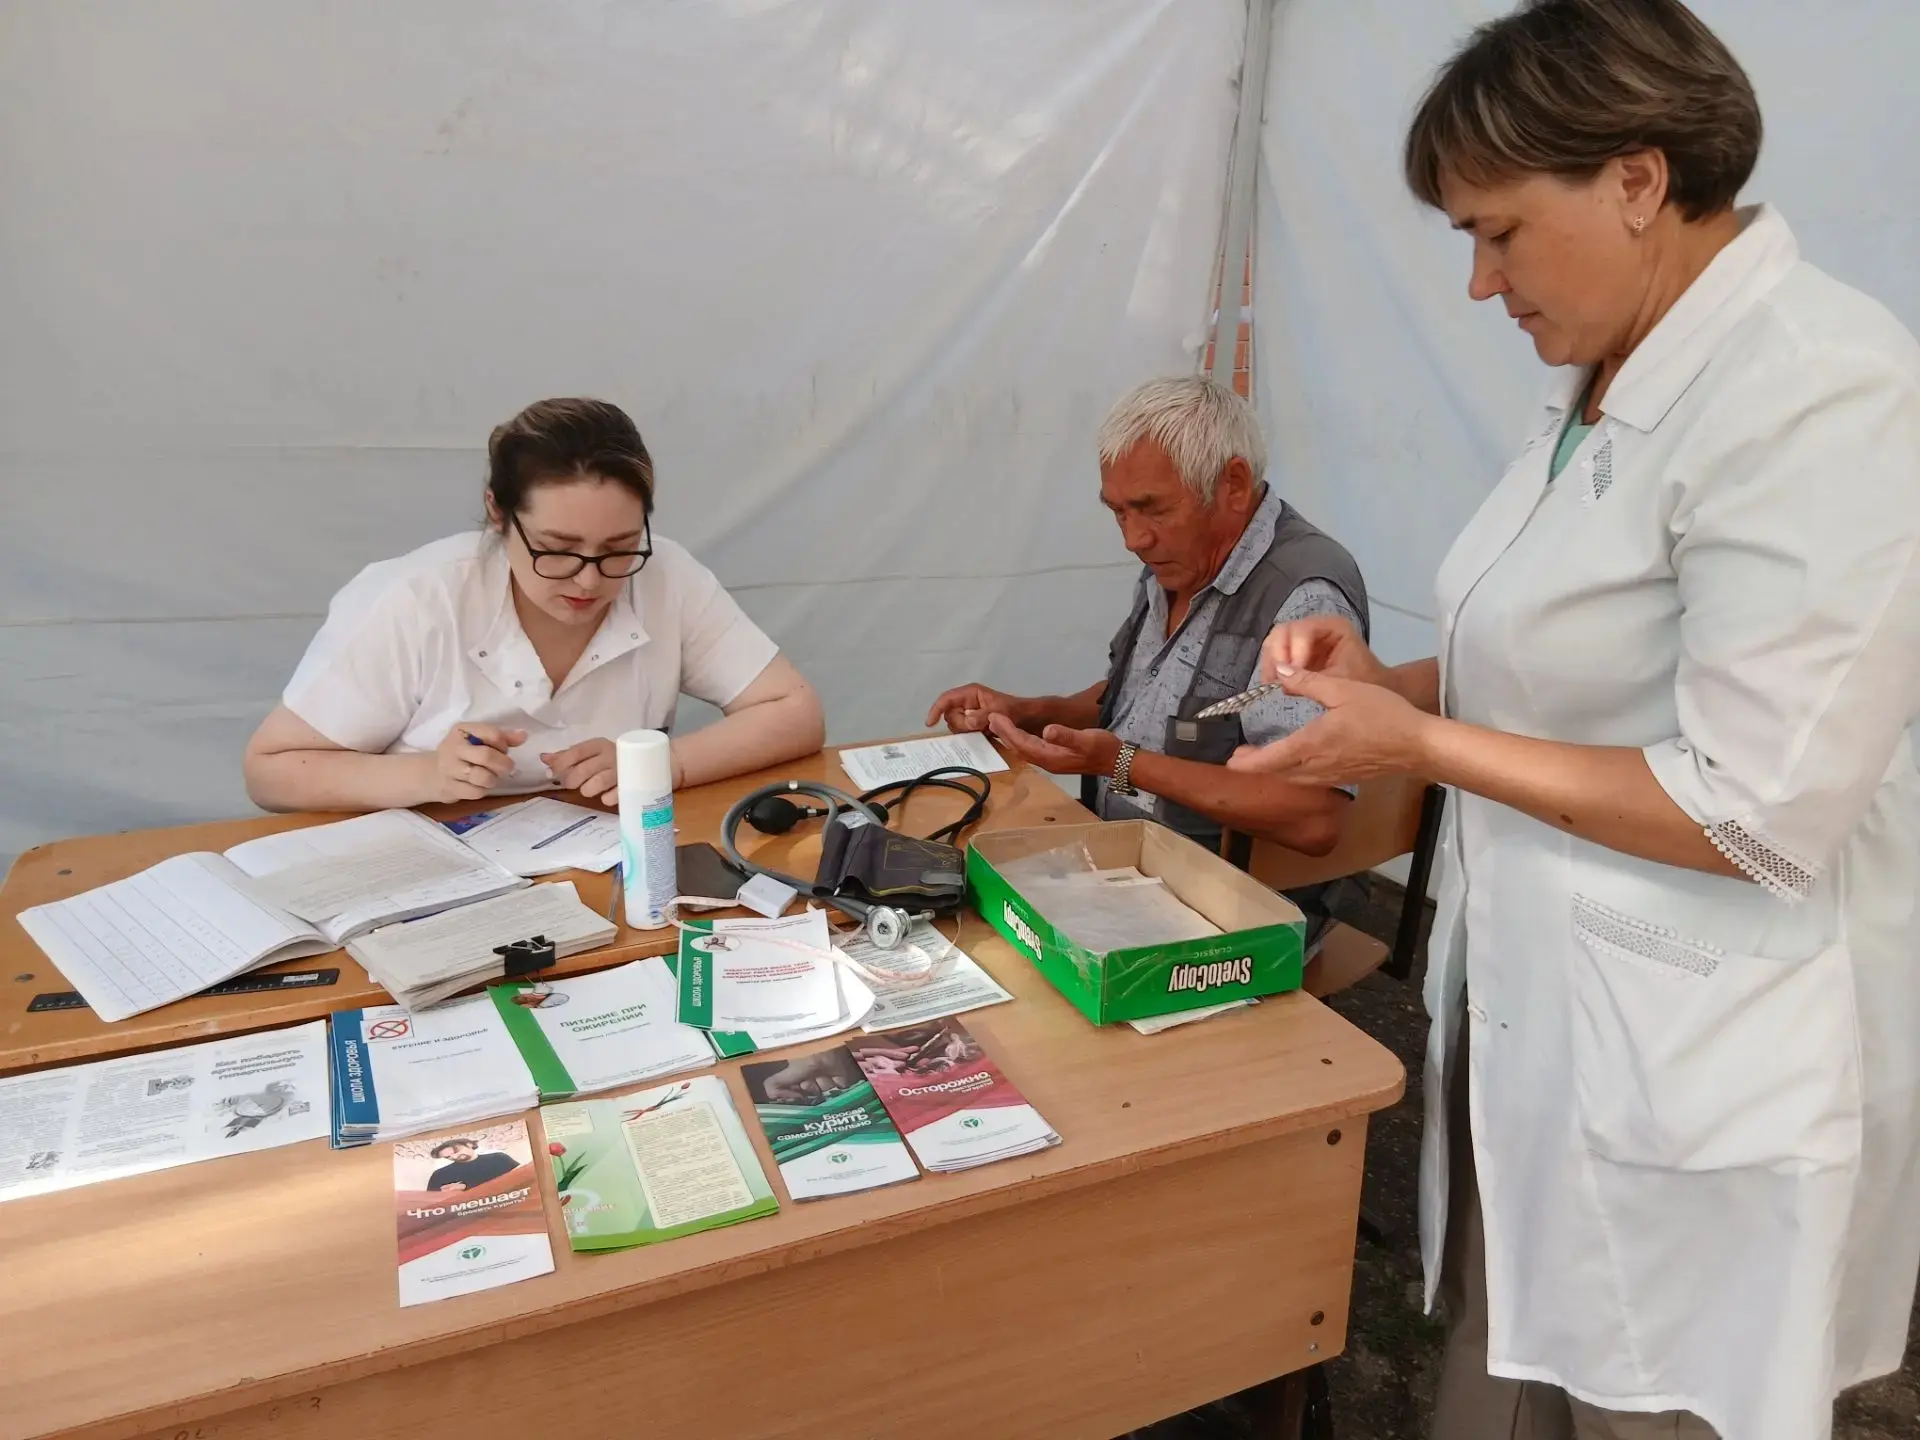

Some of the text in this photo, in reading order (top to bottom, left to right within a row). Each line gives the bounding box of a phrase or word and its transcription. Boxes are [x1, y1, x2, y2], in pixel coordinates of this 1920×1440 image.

[1194, 946, 1233, 959] CLASSIC
[1168, 957, 1252, 992] SvetoCopy
[560, 1003, 647, 1028] ПИТАНИЕ ПРИ
[572, 1011, 644, 1033] ОЖИРЕНИИ
[344, 1040, 366, 1103] ШКОЛА ЗДОРОВЬЯ
[803, 1113, 869, 1132] курить
[822, 1106, 866, 1121] Бросай
[777, 1120, 872, 1141] самостоятельно
[406, 1186, 531, 1219] Что мешает
